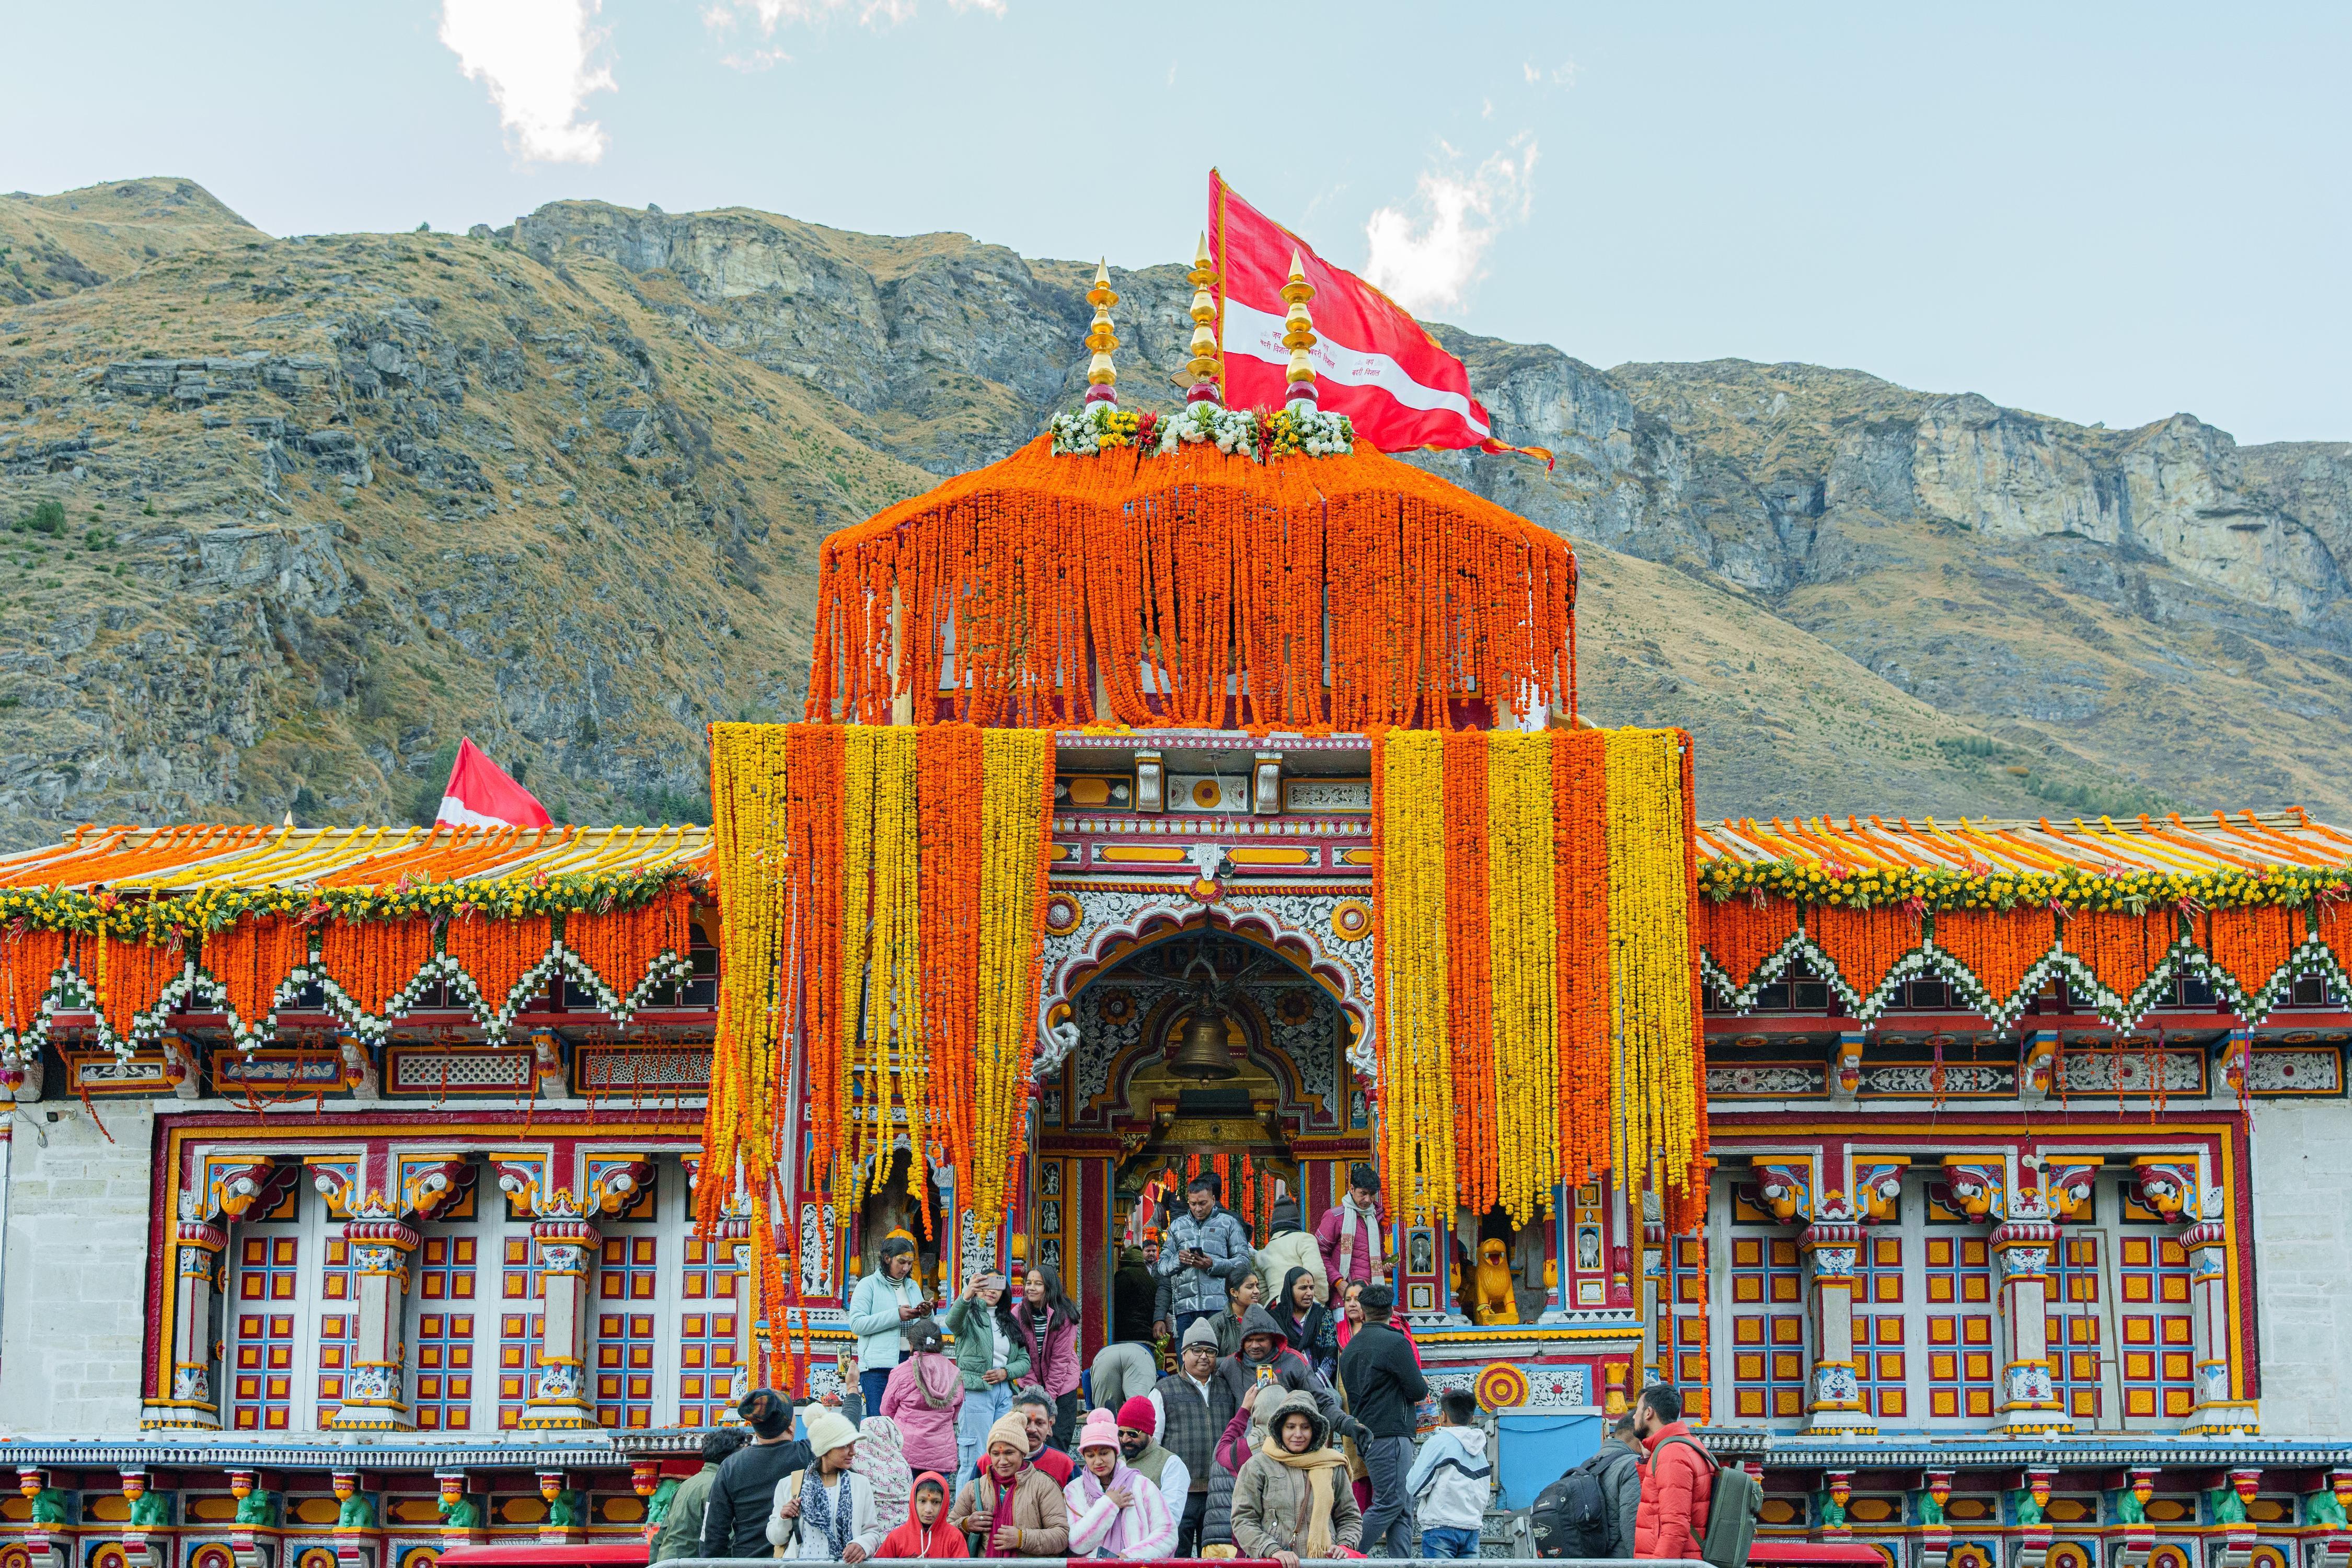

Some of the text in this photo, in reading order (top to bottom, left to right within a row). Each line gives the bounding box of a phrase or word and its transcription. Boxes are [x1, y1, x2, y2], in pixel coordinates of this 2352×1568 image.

[1272, 331, 1282, 340] जय
[1260, 339, 1292, 355] बदरी विशाल
[1310, 348, 1321, 358] बदरी
[1352, 367, 1380, 376] बदरी विशाल
